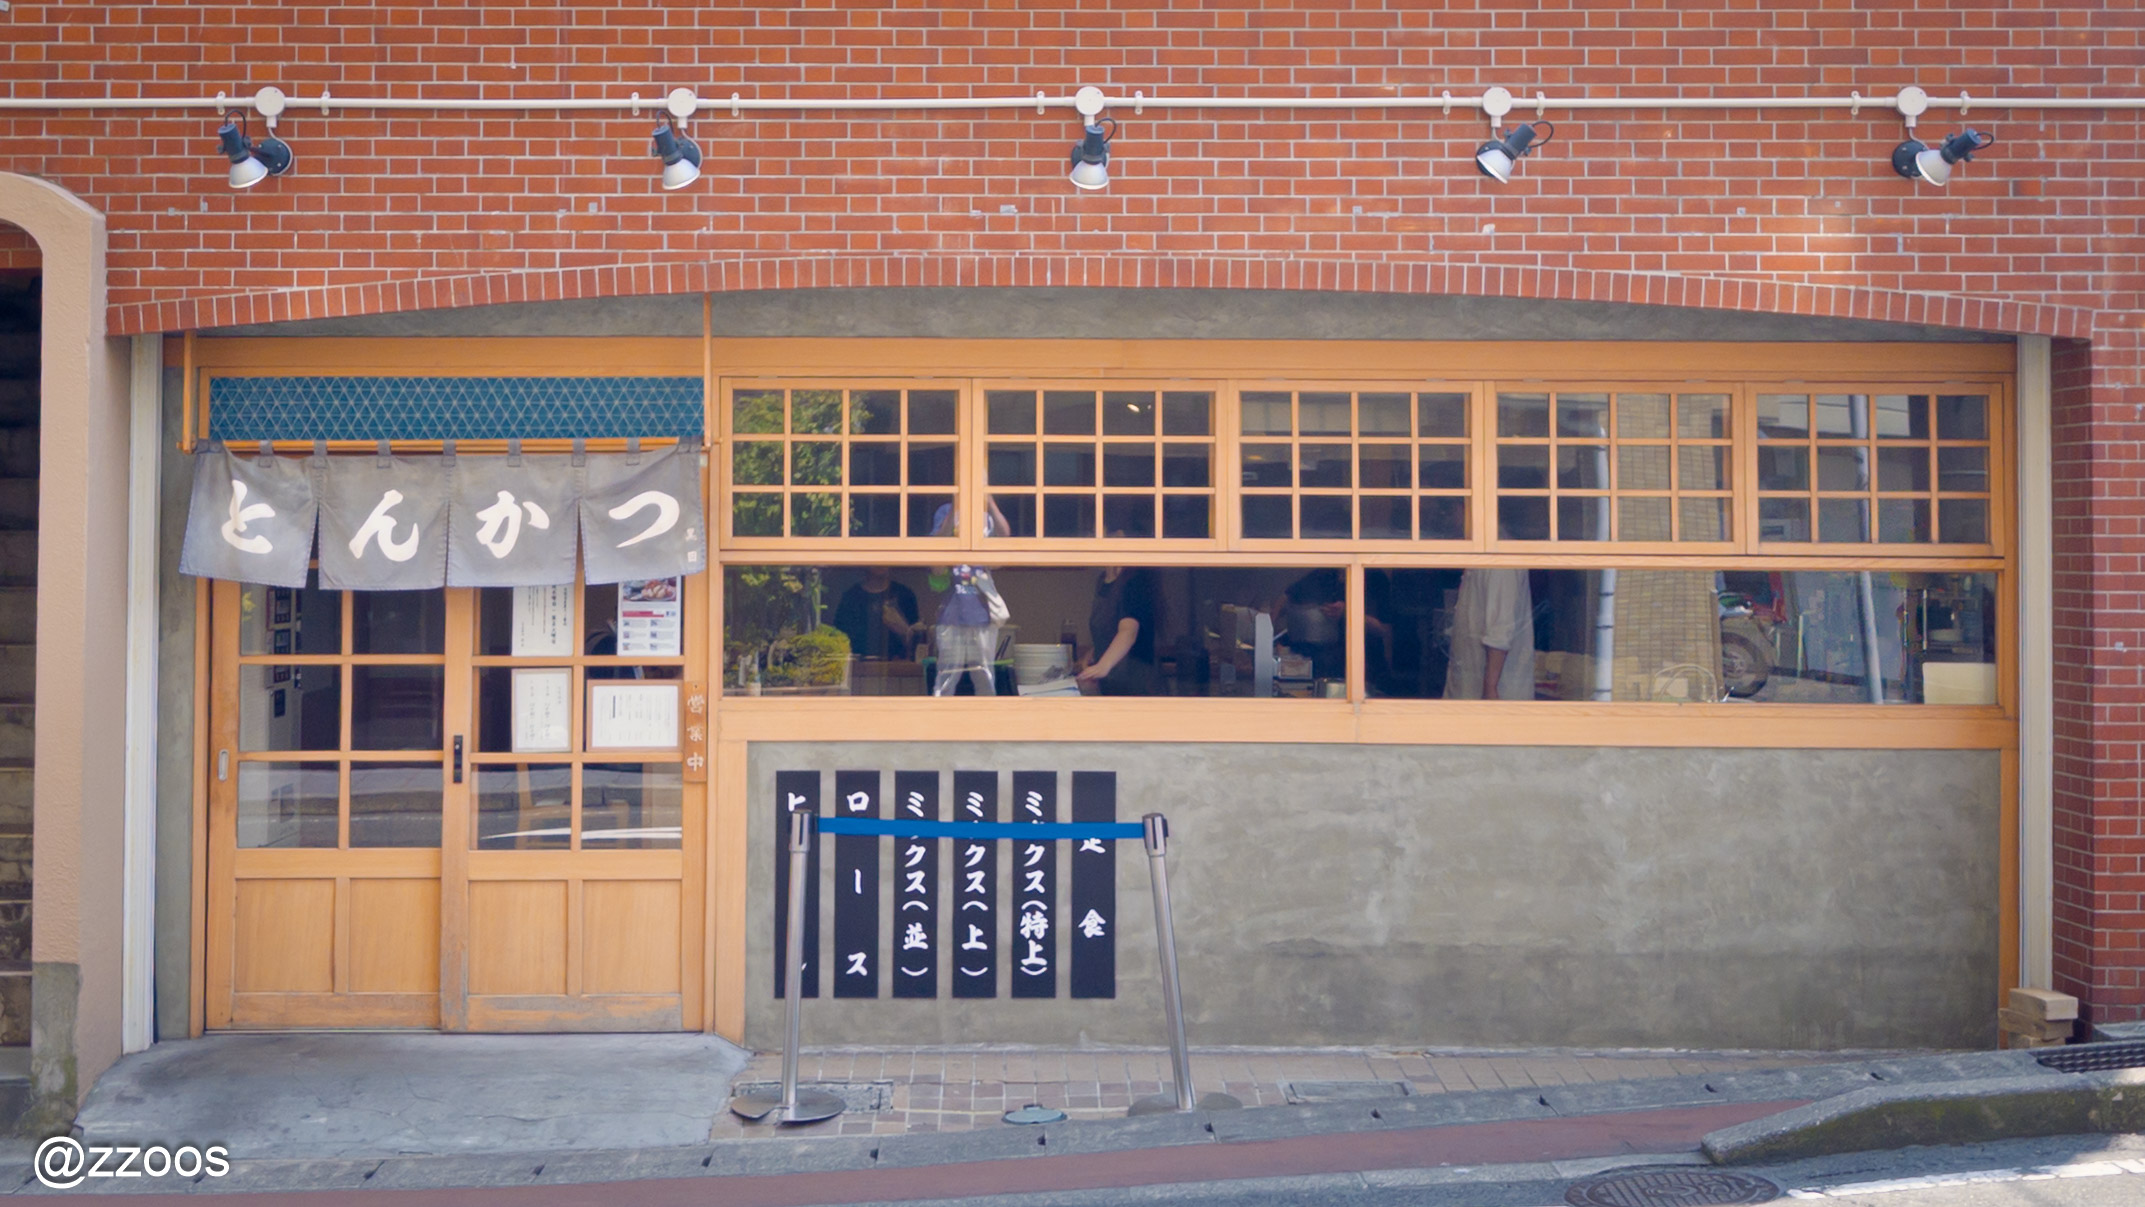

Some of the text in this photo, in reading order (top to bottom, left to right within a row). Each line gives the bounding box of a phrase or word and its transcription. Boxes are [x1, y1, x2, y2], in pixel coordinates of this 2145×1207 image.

[220, 479, 681, 562] とんかつ
[686, 693, 705, 772] 営業中
[846, 791, 870, 976] ロース
[901, 791, 929, 977] ミクス（並）
[961, 791, 989, 977] ミクス（上）
[1020, 791, 1049, 976] ミクス（特上）
